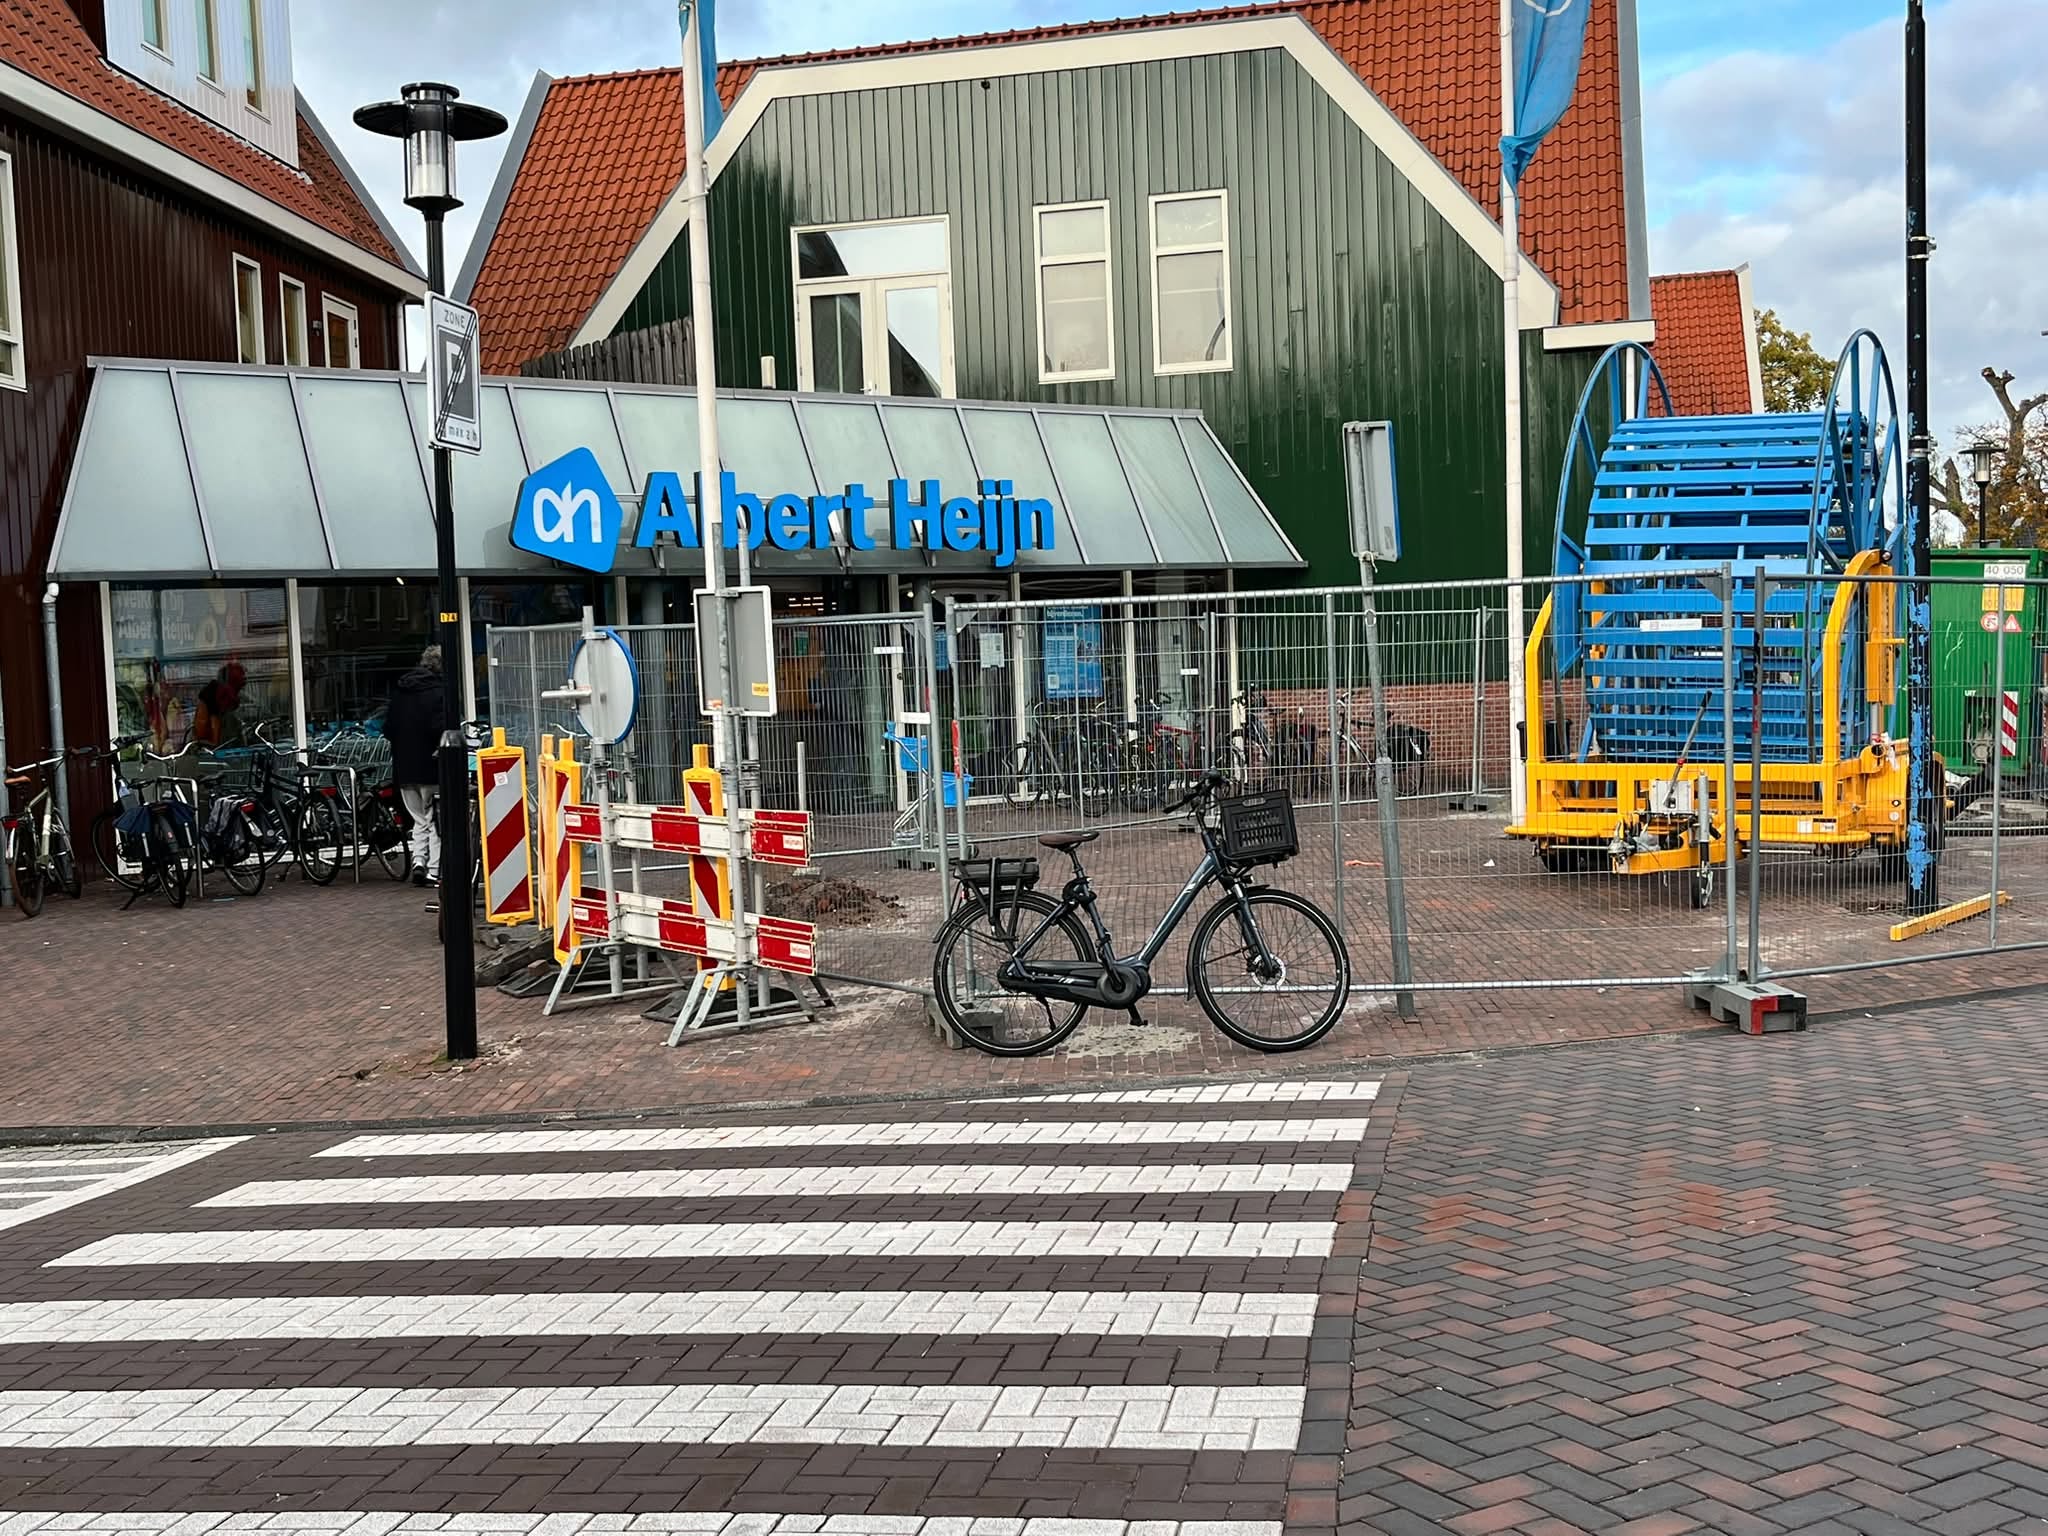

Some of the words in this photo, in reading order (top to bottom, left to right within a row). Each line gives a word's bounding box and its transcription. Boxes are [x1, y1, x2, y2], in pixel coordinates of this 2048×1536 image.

[444, 309, 465, 329] ZONE
[446, 341, 467, 404] P
[632, 471, 876, 551] Abert
[888, 478, 1055, 568] Heijn
[1985, 565, 1999, 575] 40
[2003, 565, 2024, 575] 050
